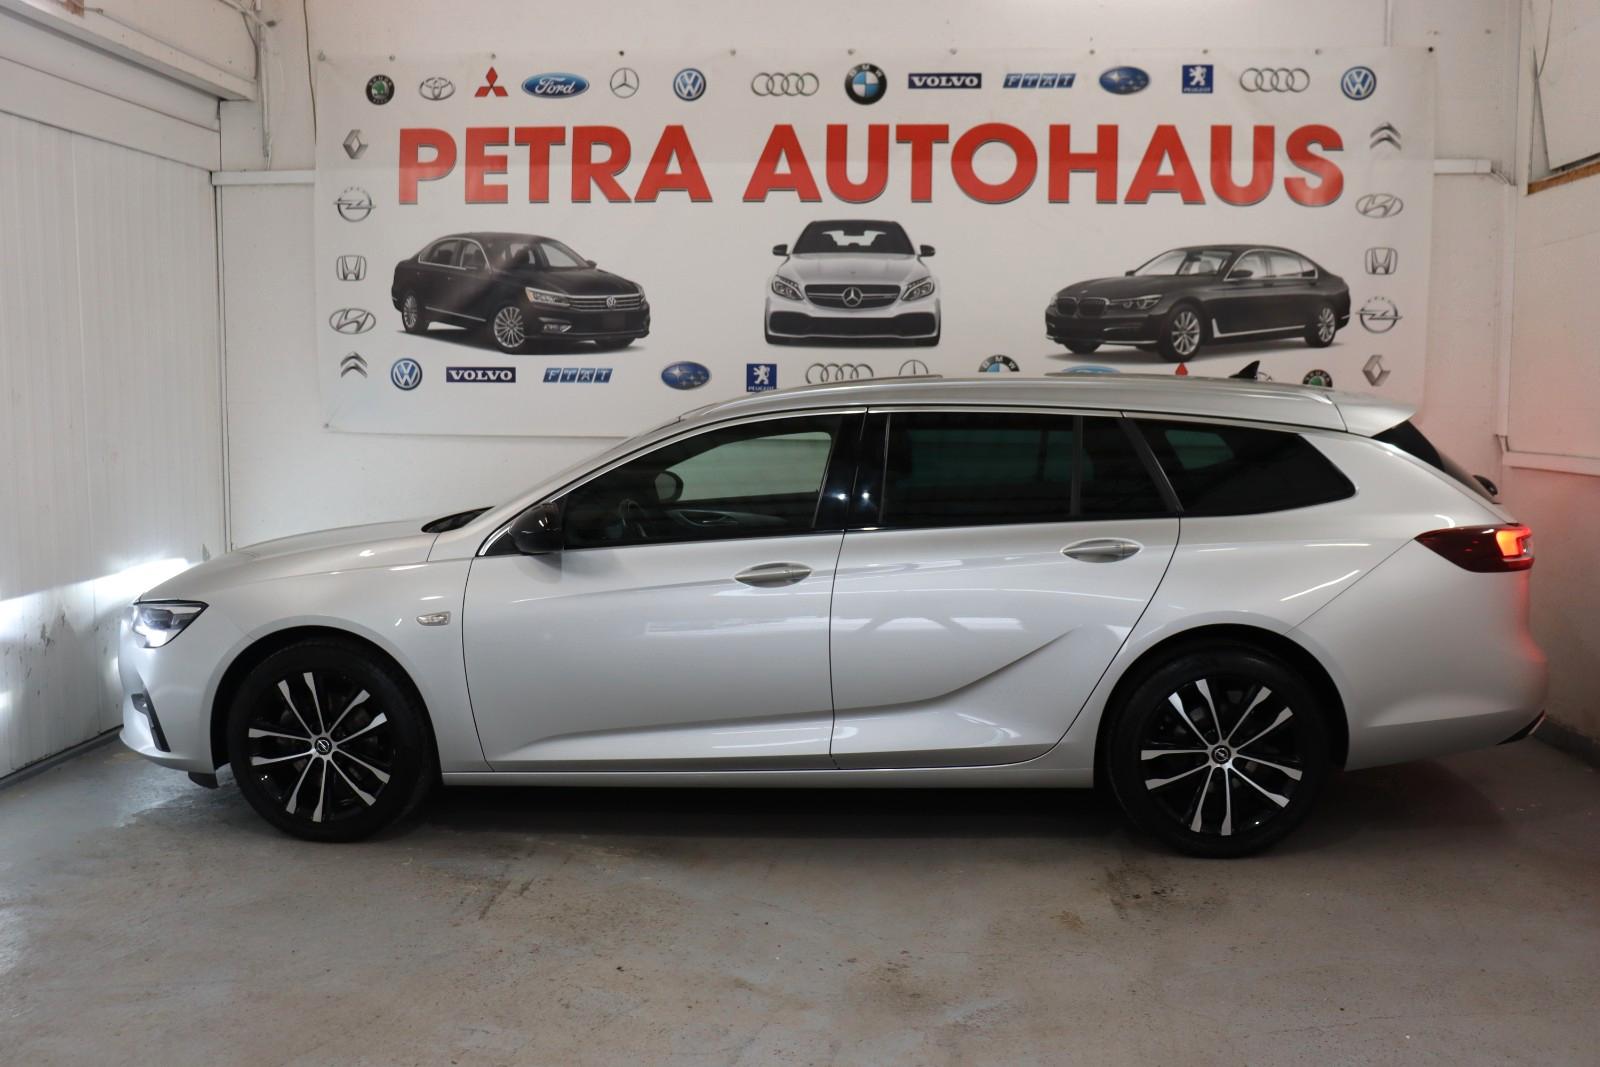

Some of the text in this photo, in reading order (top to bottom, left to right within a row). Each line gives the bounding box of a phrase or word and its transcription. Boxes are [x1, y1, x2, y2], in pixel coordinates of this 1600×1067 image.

[534, 77, 577, 95] Ford
[910, 75, 979, 87] VOLVO
[398, 122, 1344, 207] PETRA AUTOHAUS
[982, 355, 1017, 369] BMW
[448, 369, 514, 381] VOLVO
